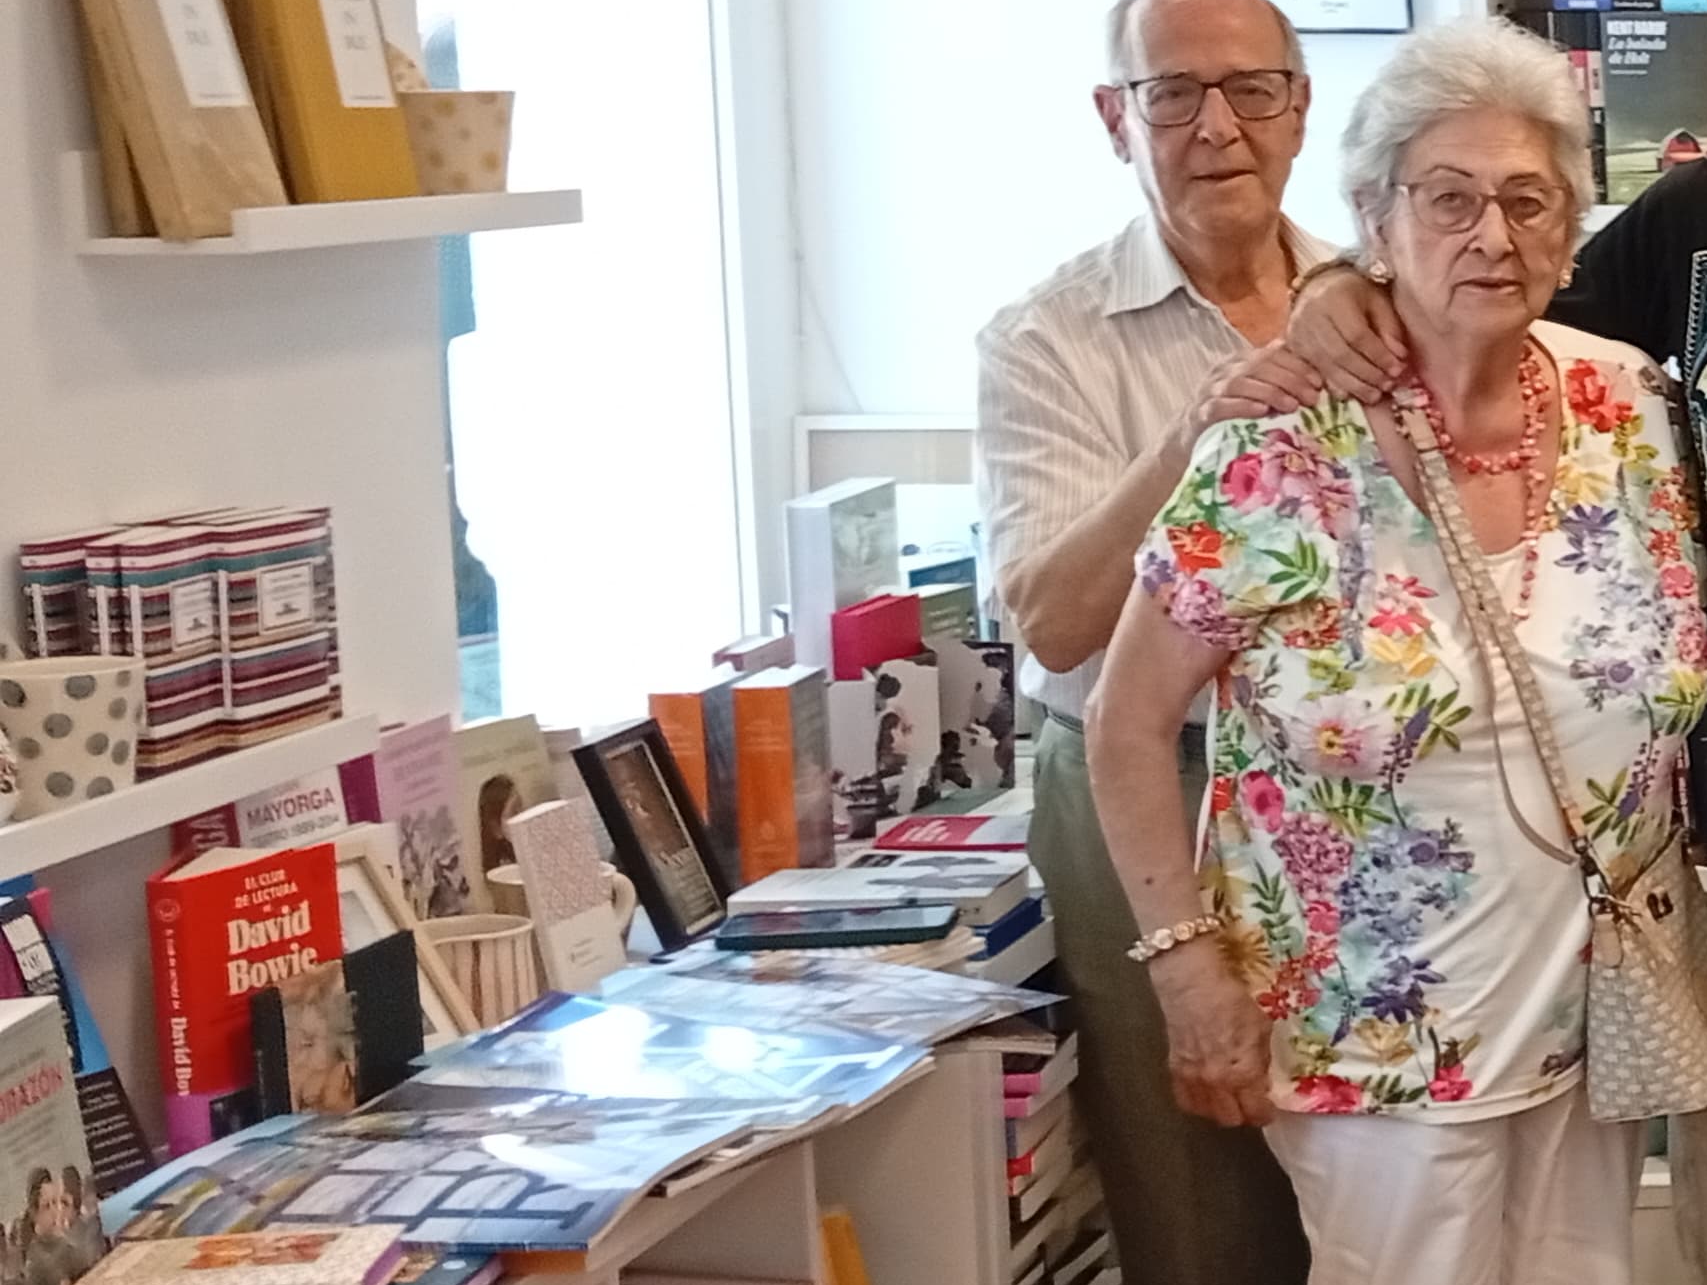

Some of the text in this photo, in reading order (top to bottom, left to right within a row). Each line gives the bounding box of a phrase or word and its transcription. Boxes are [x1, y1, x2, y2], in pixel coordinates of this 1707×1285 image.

[247, 787, 335, 824] MAYORGA
[234, 881, 298, 909] DE LECTURA
[258, 868, 286, 886] CLUB
[227, 899, 312, 956] David
[227, 943, 319, 996] Bowie
[171, 1016, 191, 1066] David
